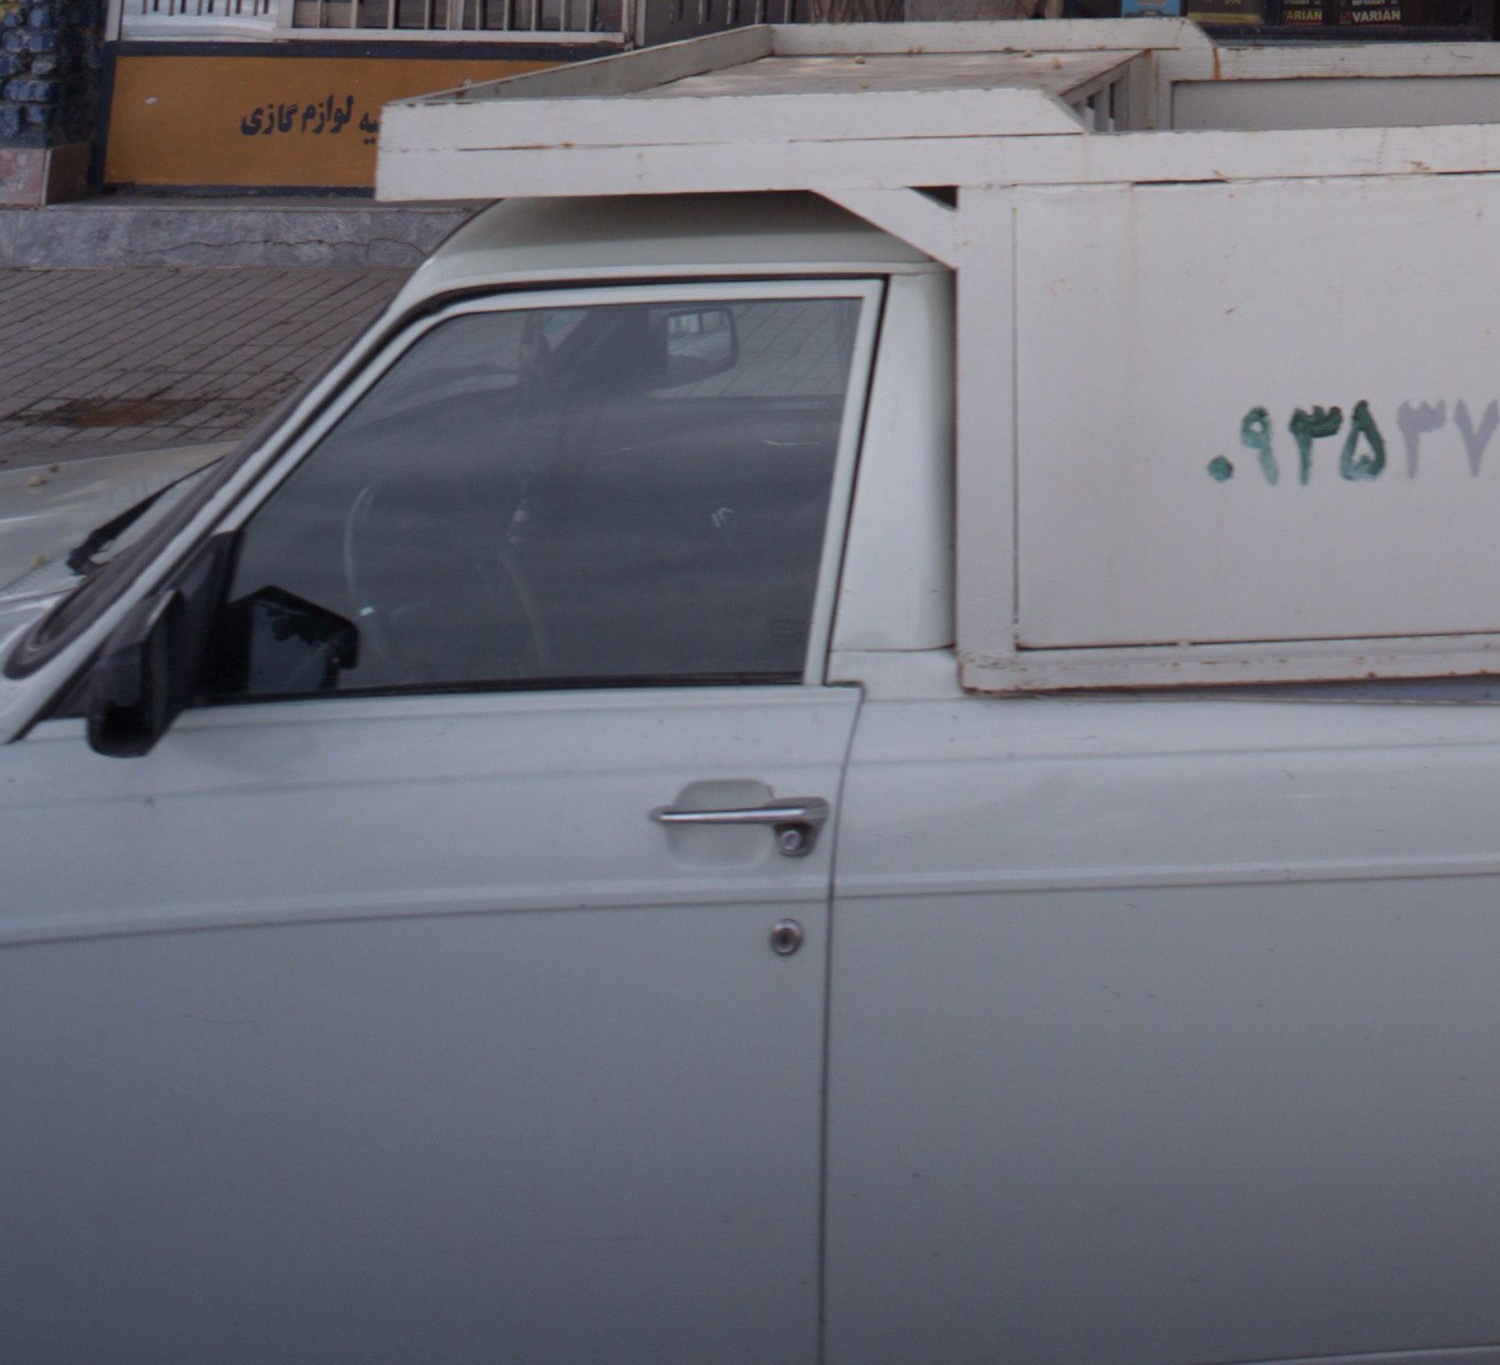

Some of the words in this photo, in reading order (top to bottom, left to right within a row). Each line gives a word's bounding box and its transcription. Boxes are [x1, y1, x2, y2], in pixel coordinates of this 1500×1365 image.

[1351, 9, 1402, 23] VARIAN
[241, 103, 298, 135] گازی
[302, 94, 354, 134] لوازم
